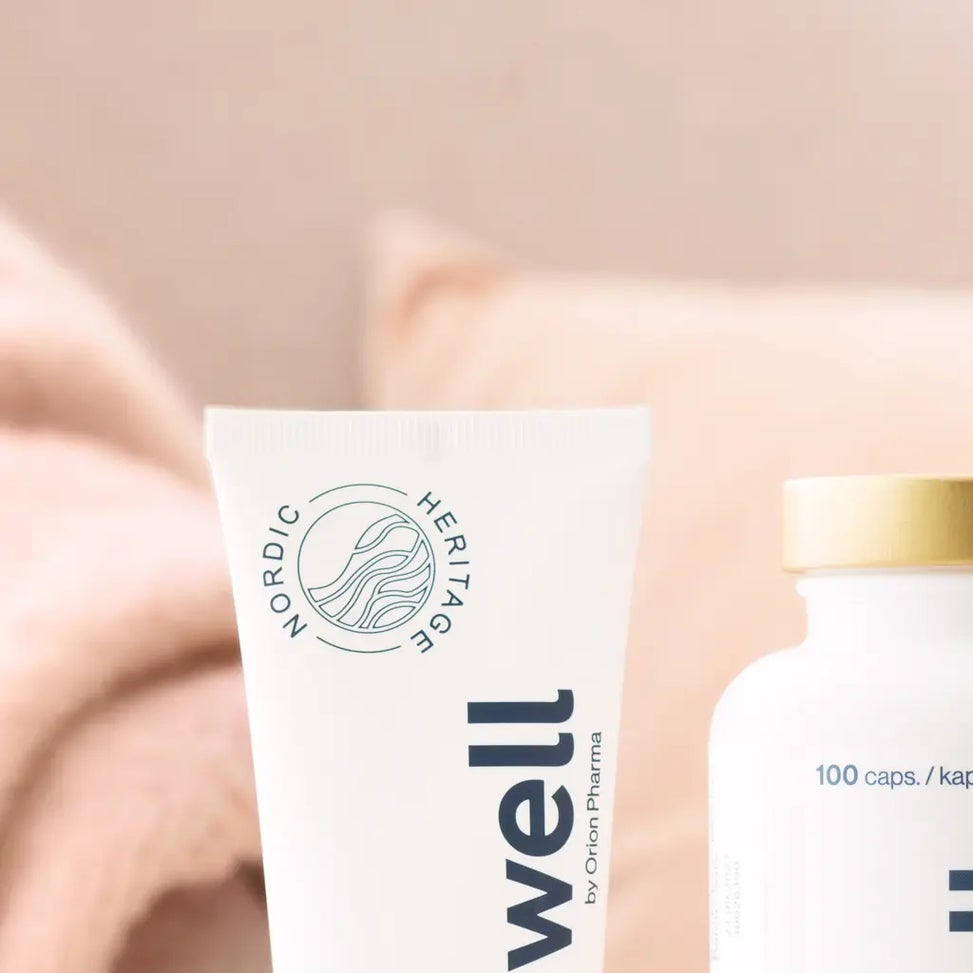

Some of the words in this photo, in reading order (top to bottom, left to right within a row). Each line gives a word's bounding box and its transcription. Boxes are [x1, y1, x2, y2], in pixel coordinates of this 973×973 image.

[263, 505, 309, 638] NORDIC
[410, 491, 471, 653] HERITAGE
[587, 731, 602, 811] Pharma
[815, 763, 859, 787] 100
[864, 770, 921, 791] caps.
[924, 765, 936, 788] /
[466, 689, 575, 972] well
[585, 816, 599, 875] Orion
[584, 880, 599, 905] by
